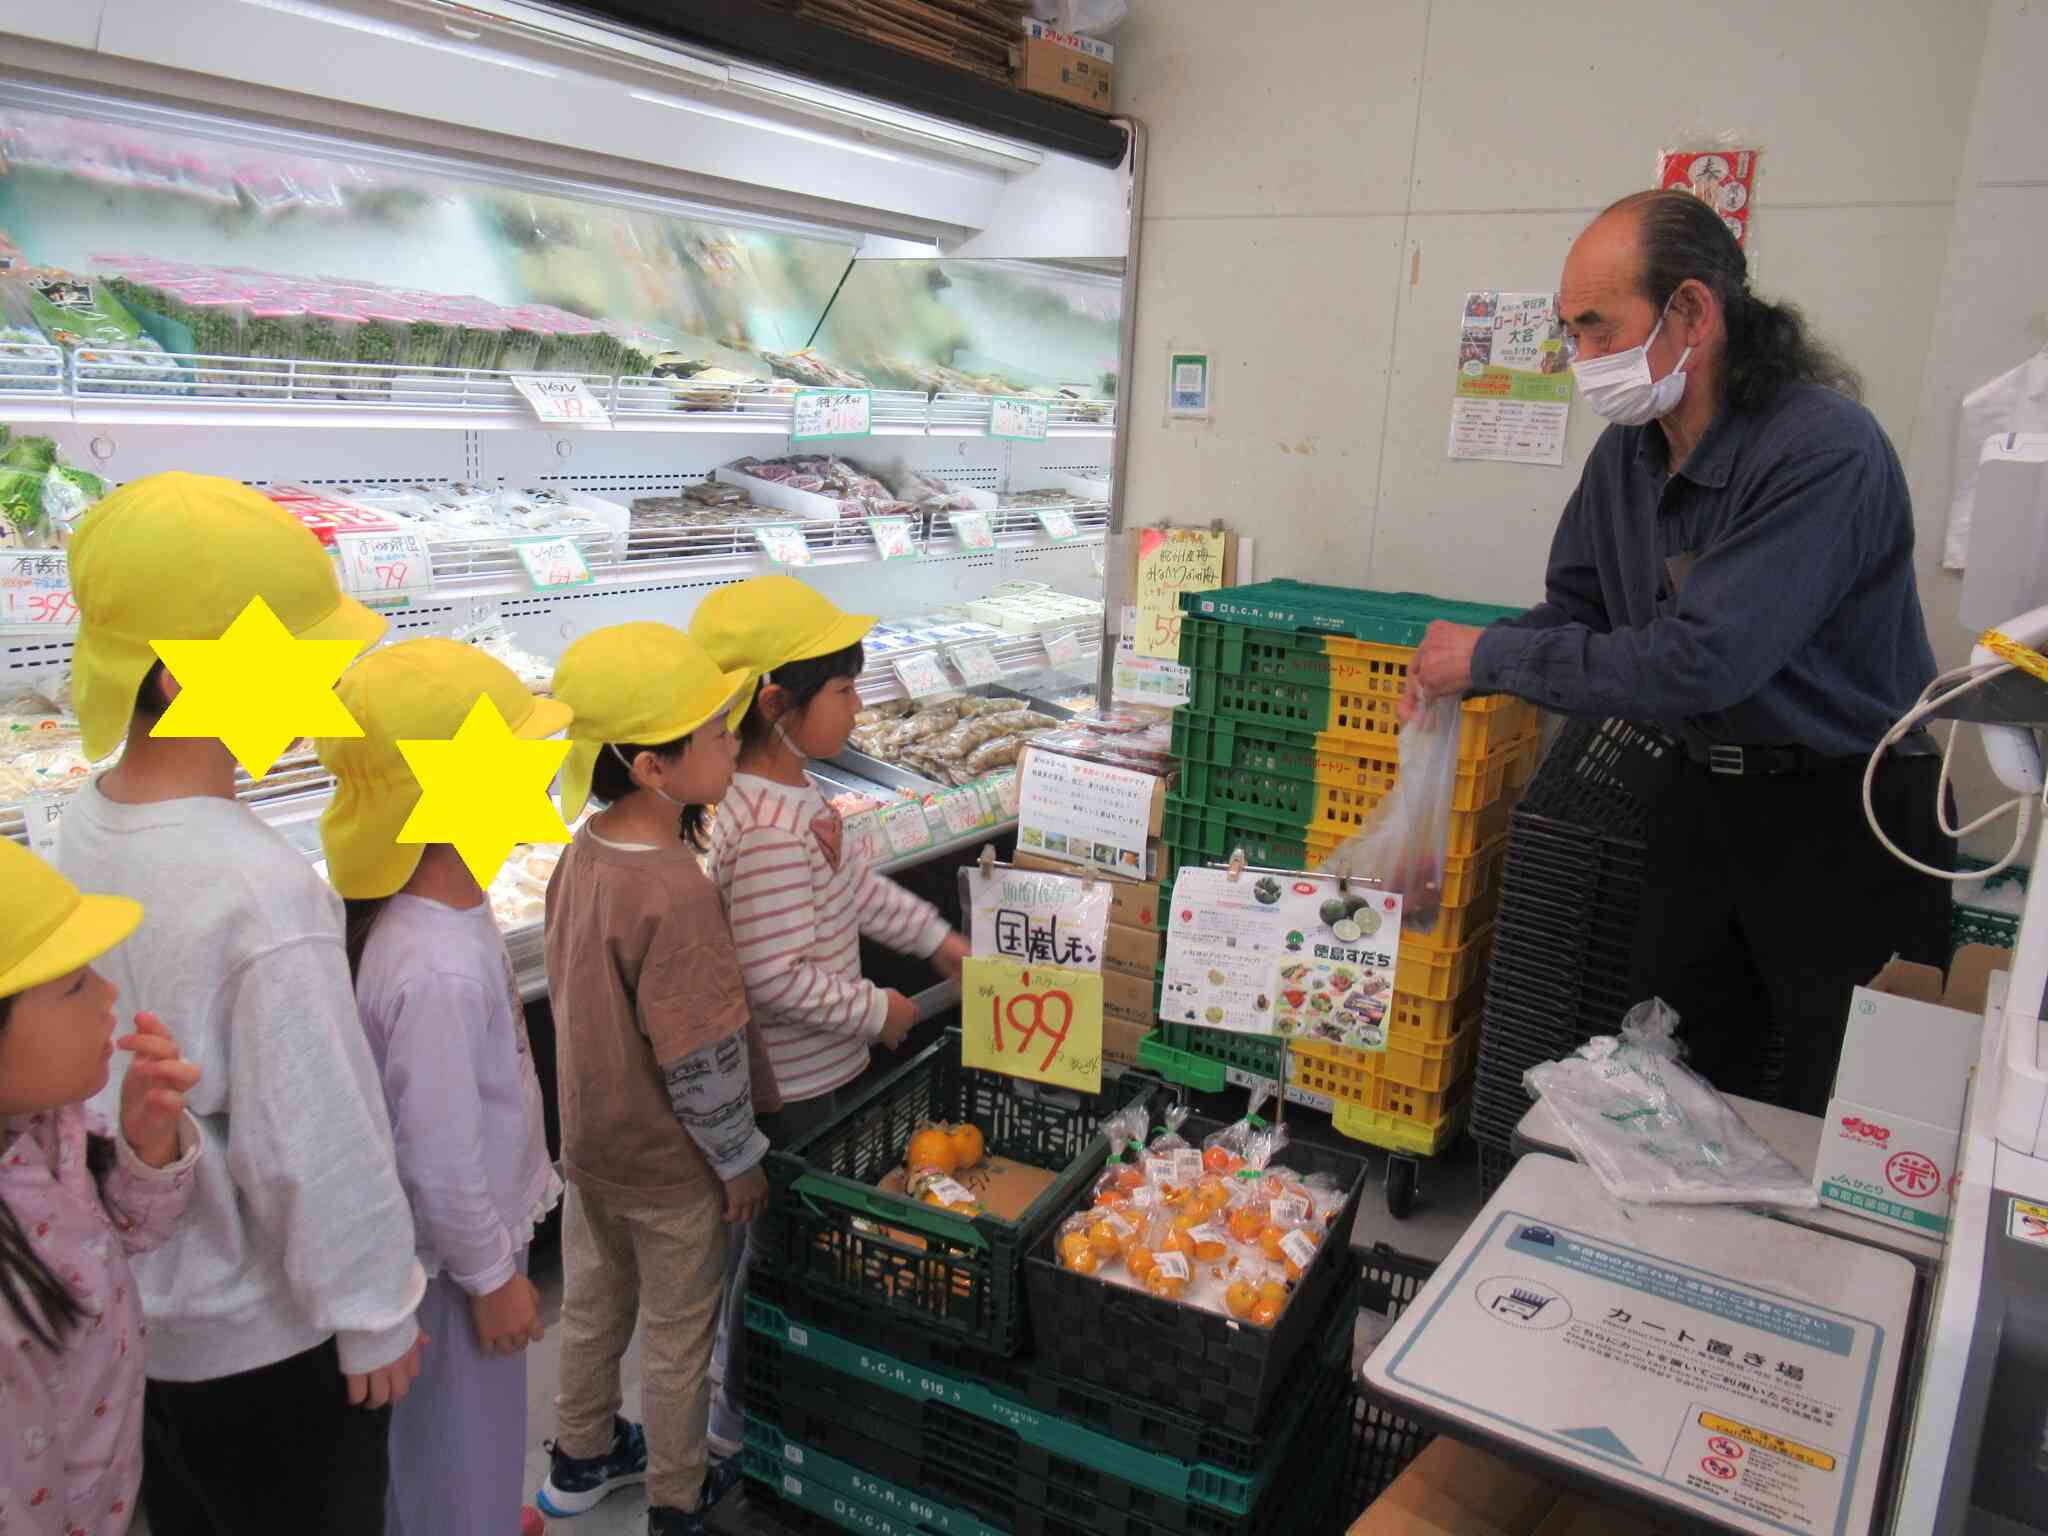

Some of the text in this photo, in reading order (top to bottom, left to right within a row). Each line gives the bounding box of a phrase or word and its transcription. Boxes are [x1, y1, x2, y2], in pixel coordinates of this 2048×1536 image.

[1508, 328, 1535, 345] 大会
[375, 561, 408, 589] 79
[995, 908, 1097, 964] 国産レモン
[993, 990, 1073, 1072] 199
[1607, 1307, 1804, 1382] カート置き場
